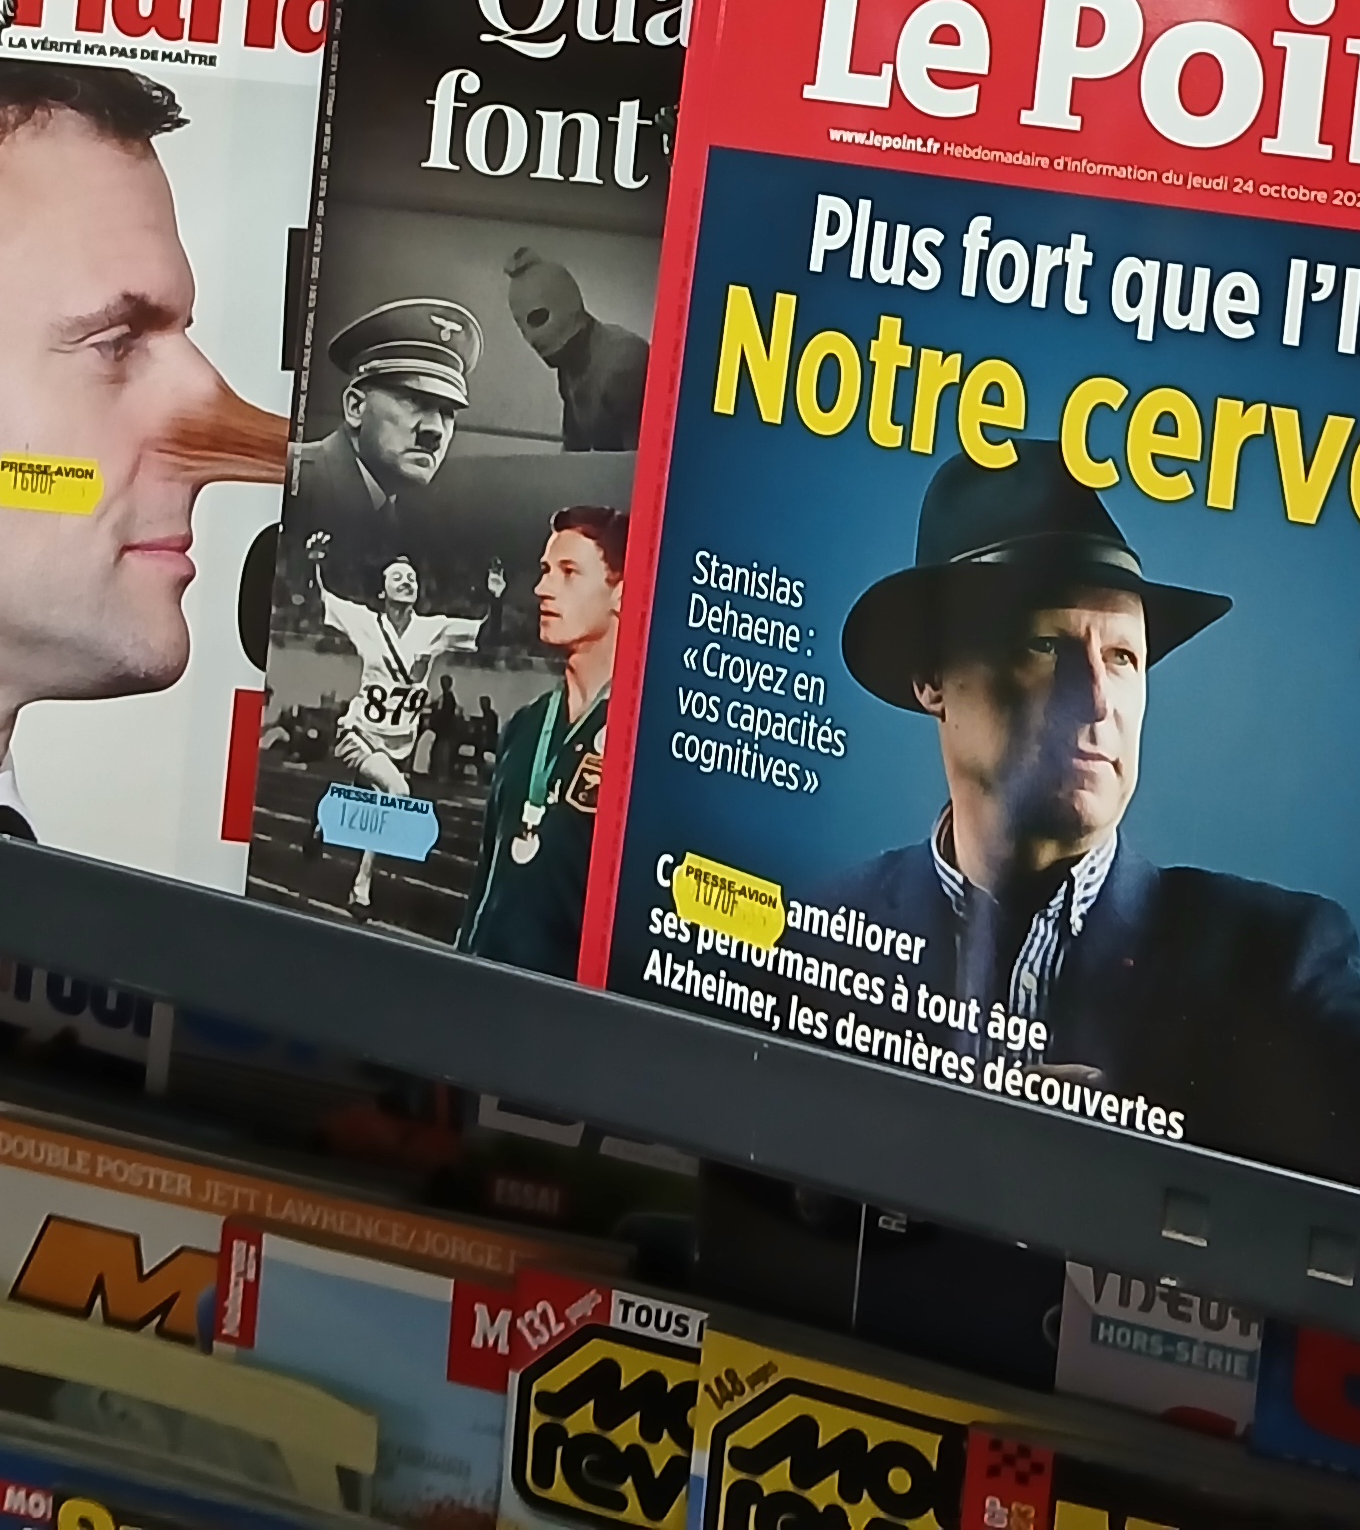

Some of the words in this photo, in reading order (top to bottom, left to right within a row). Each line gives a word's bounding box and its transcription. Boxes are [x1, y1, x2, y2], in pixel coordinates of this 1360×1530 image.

[8, 37, 26, 49] LA
[31, 38, 81, 54] VÉRITÉ
[111, 45, 138, 60] PAS
[141, 49, 159, 61] DE
[161, 46, 217, 66] MAÎTRE
[943, 142, 1049, 169] Hebdomadaire
[1259, 181, 1327, 205] octobre
[809, 194, 943, 291] Plus
[961, 217, 1092, 315] fort
[1112, 256, 1259, 341] que
[713, 284, 1026, 470] Notre
[692, 550, 805, 608] Stanislas
[727, 697, 846, 757] capacités
[329, 785, 376, 805] PRESSE
[739, 886, 777, 908] AVION
[787, 895, 927, 965] améliorer
[643, 949, 781, 1030] Alzheimer,
[983, 1052, 1185, 1141] découvertes
[95, 1151, 192, 1199] POSTER
[619, 1299, 689, 1338] TOUS
